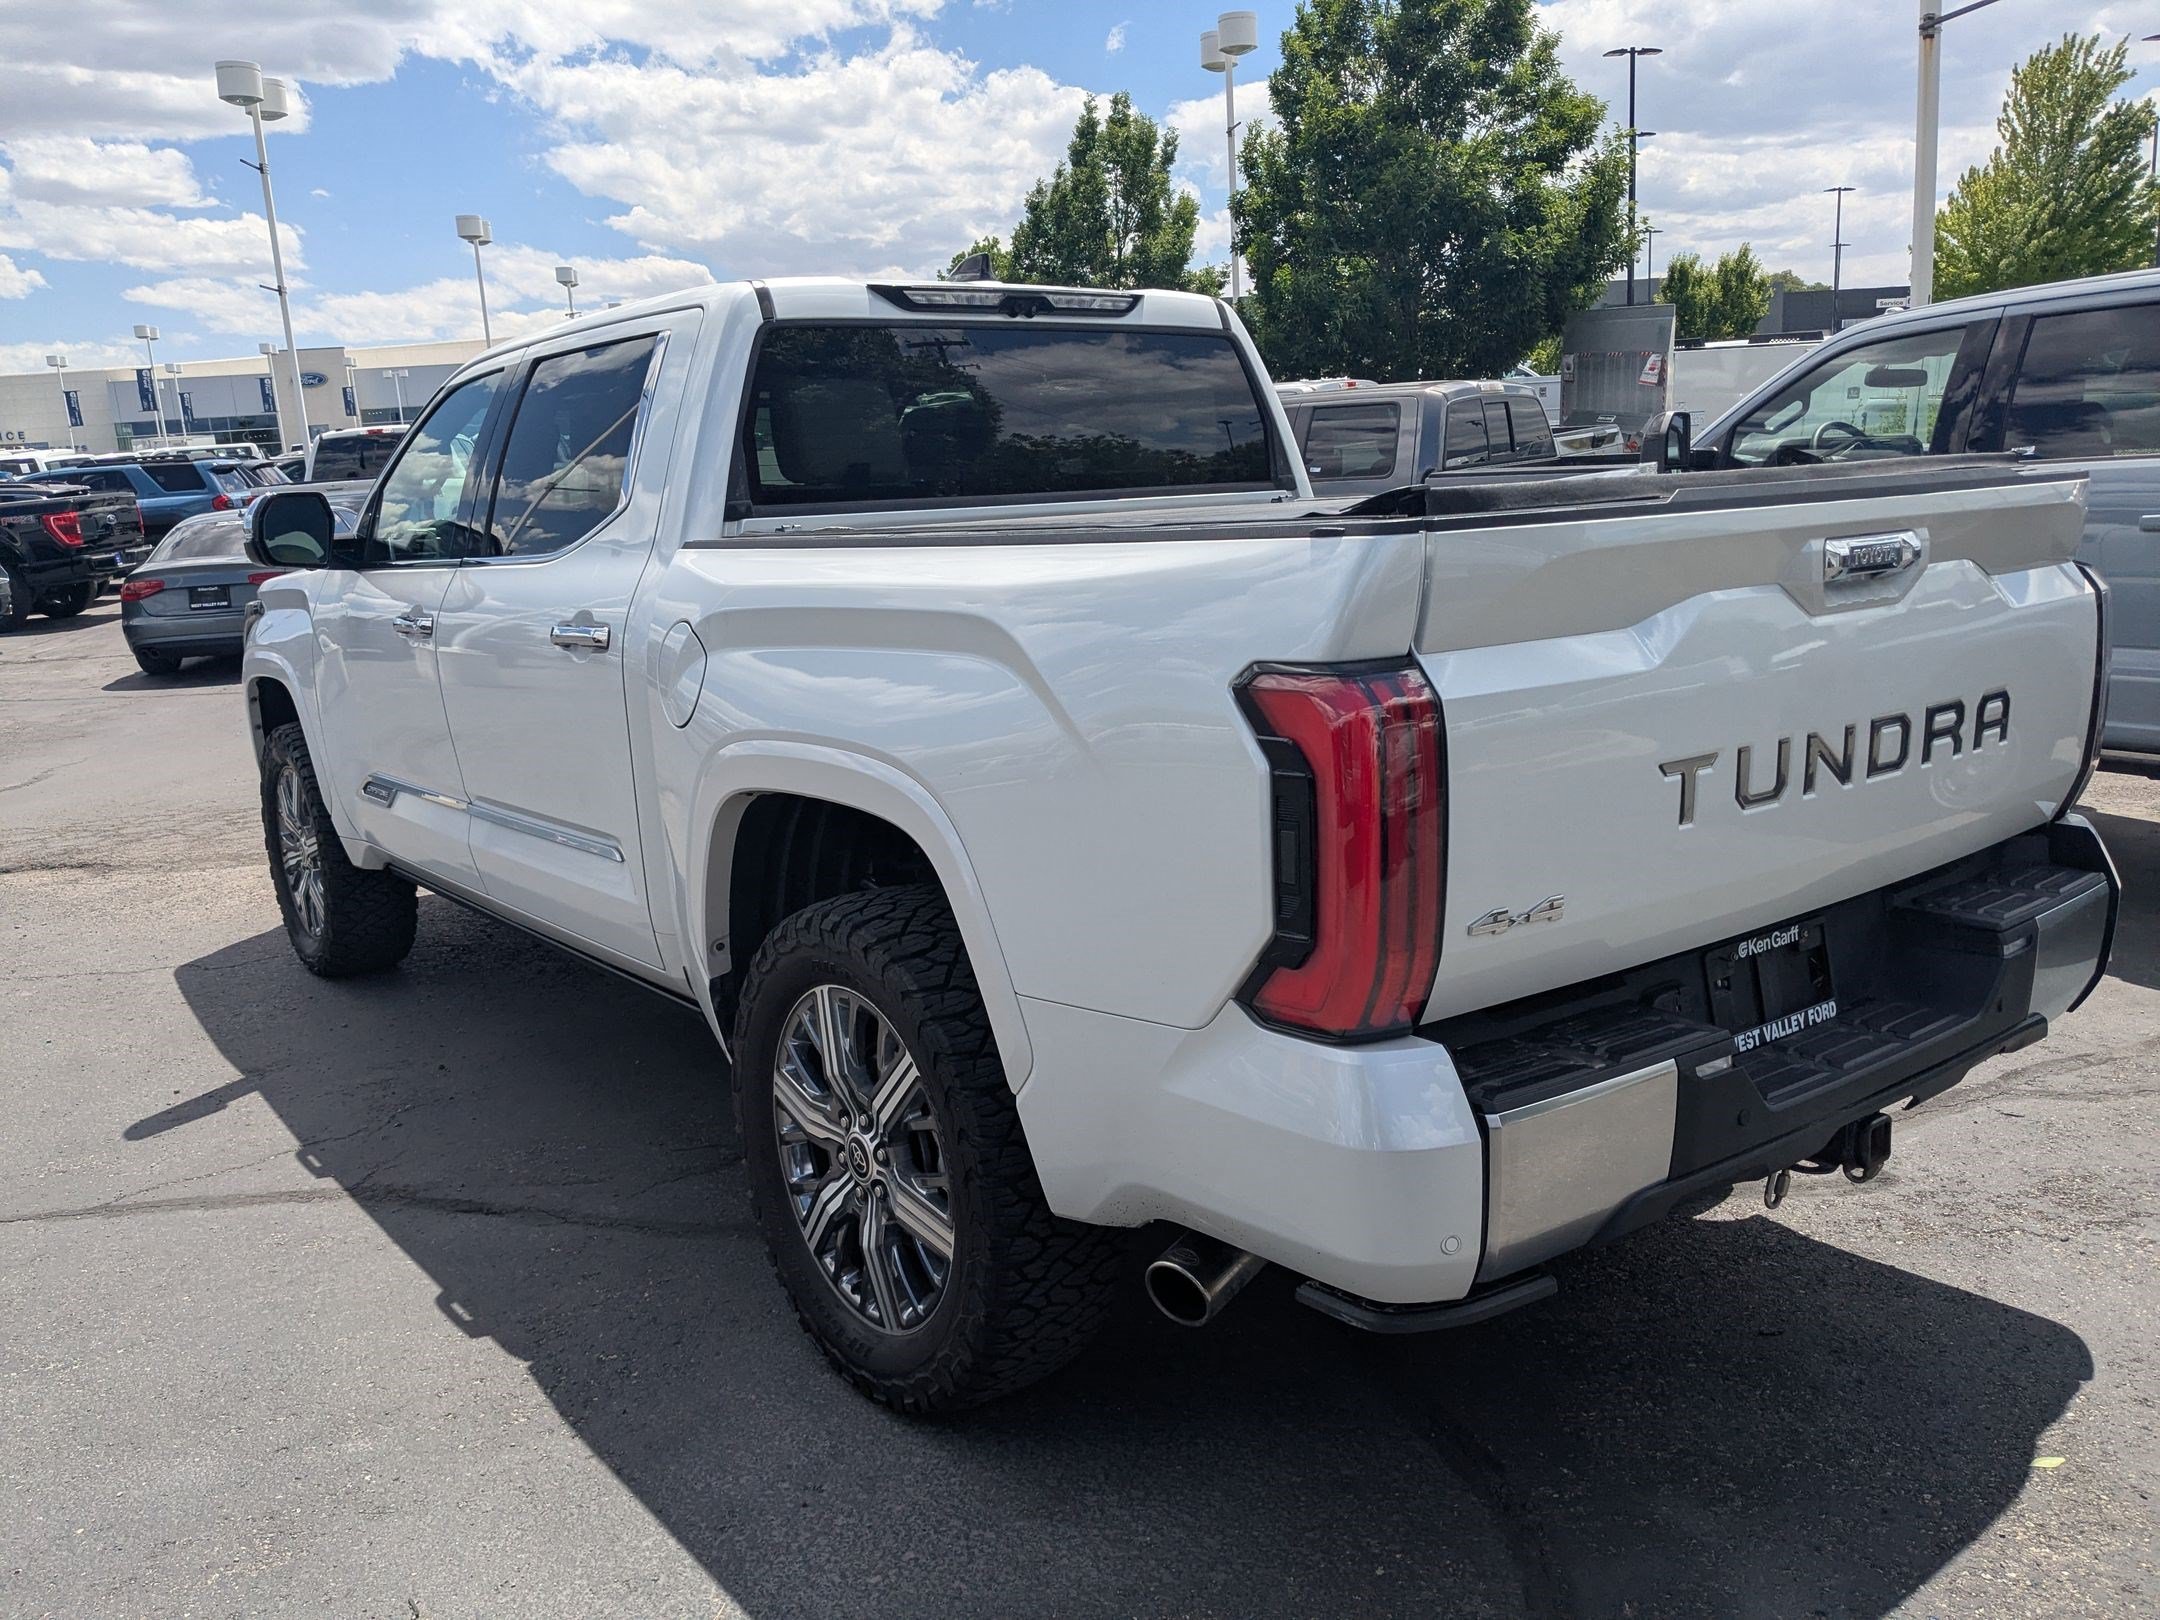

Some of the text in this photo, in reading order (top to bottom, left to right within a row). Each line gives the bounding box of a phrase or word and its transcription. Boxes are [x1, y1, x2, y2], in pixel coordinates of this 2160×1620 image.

[1853, 545, 1897, 565] TOYOTA
[1658, 687, 2011, 827] TUNDRA
[1466, 893, 1565, 936] 4x4
[1748, 925, 1799, 956] Ken Garff
[1763, 1012, 1805, 1042] VALLEY
[1808, 1000, 1837, 1026] FORD
